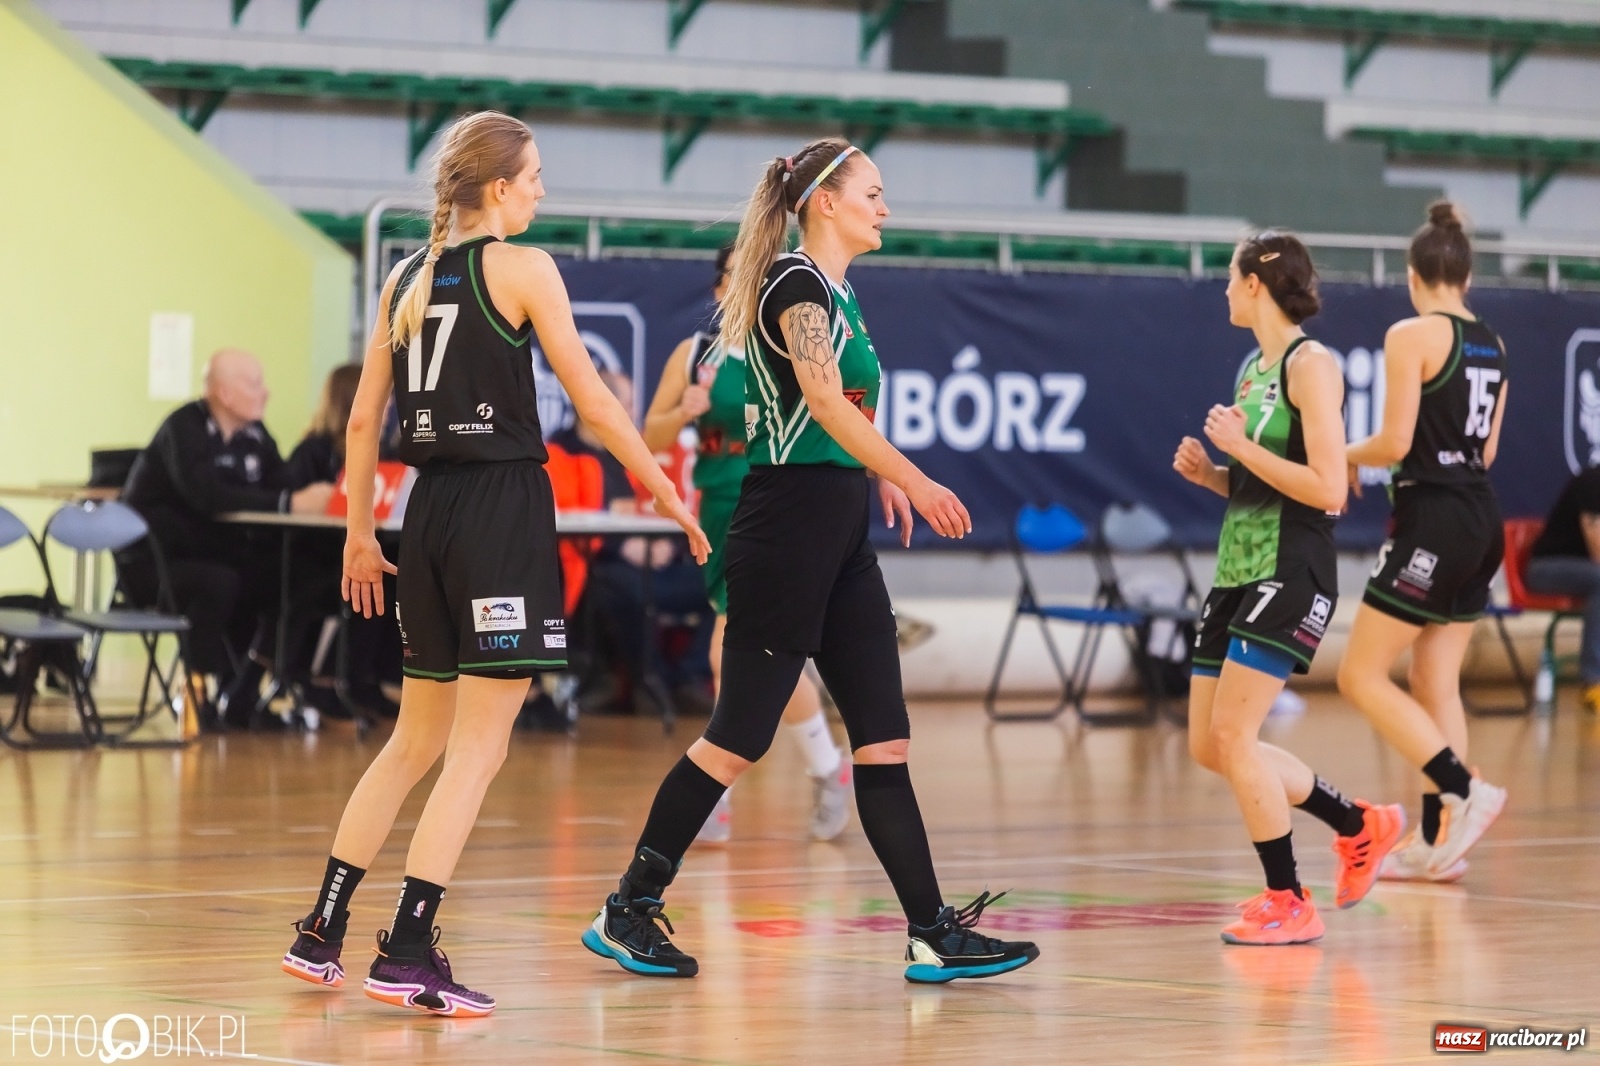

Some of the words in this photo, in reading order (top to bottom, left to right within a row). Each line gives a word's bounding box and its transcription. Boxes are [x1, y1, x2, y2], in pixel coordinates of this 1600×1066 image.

[408, 304, 459, 392] 17
[1465, 366, 1501, 439] 15
[1253, 404, 1275, 444] 7
[543, 619, 560, 627] COPY
[1245, 585, 1277, 623] 7
[479, 634, 520, 651] LUCY
